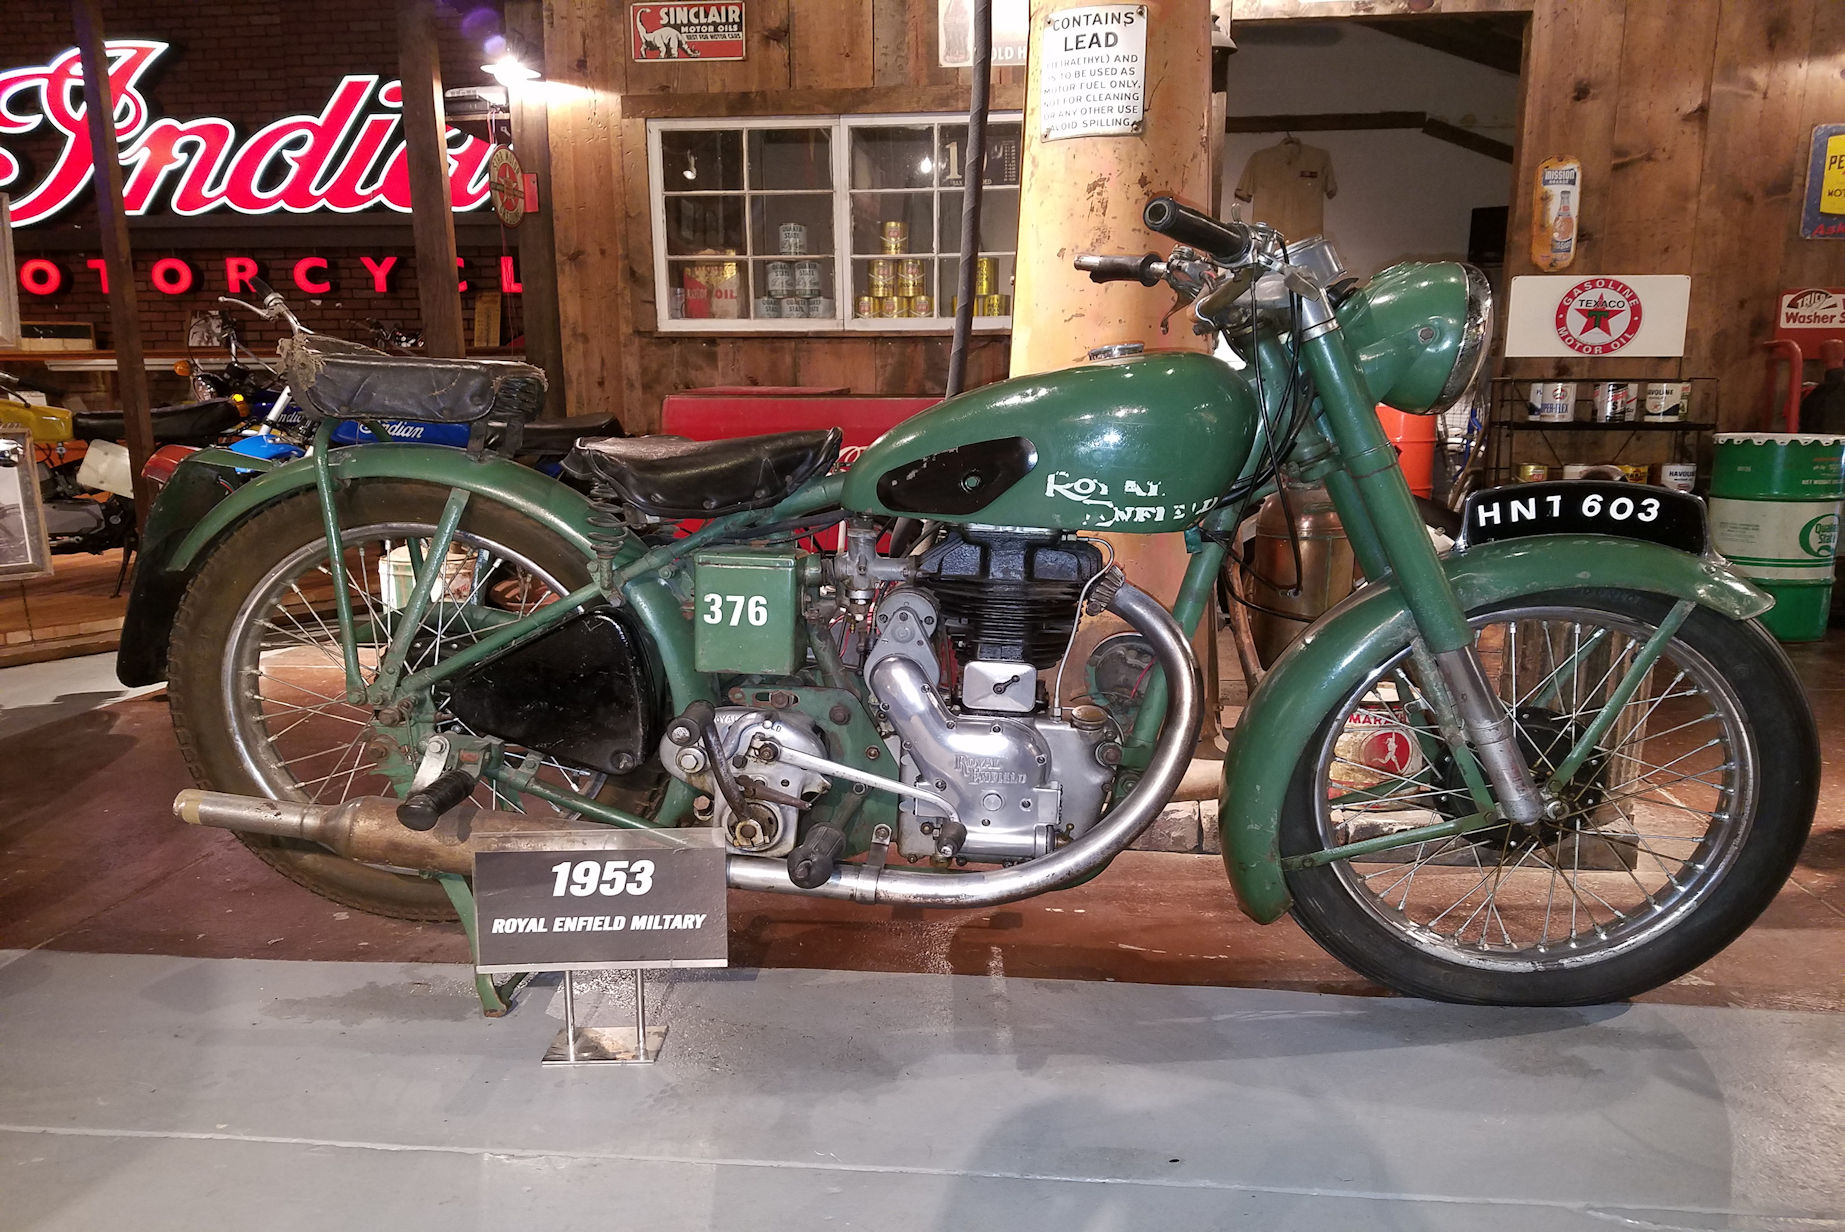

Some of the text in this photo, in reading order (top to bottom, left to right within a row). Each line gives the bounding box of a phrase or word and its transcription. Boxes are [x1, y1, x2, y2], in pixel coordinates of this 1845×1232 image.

[660, 6, 741, 25] SINCLAIR
[1053, 12, 1135, 32] CONTAINS
[681, 24, 738, 33] MOTOR OILS
[1064, 32, 1119, 52] LEAD
[1113, 54, 1138, 63] AND
[1074, 69, 1087, 78] BE
[1089, 67, 1118, 77] USED
[1120, 66, 1136, 76] AS
[1079, 80, 1106, 90] FUEL
[1085, 92, 1140, 103] CLEANING
[1080, 105, 1114, 116] OTHER
[1117, 105, 1138, 114] USE
[714, 288, 737, 299] OIL
[1562, 279, 1640, 307] GASOLINE
[1579, 299, 1626, 308] TEXACO
[1785, 311, 1837, 324] Washer
[1557, 326, 1635, 354] MOTOR OIL
[1477, 494, 1661, 527] HNT 603
[703, 593, 768, 627] 376
[953, 754, 1001, 777] ROYAL
[551, 859, 655, 897] 1953
[492, 913, 707, 934] ROYAL ENFIELD MILTARY
